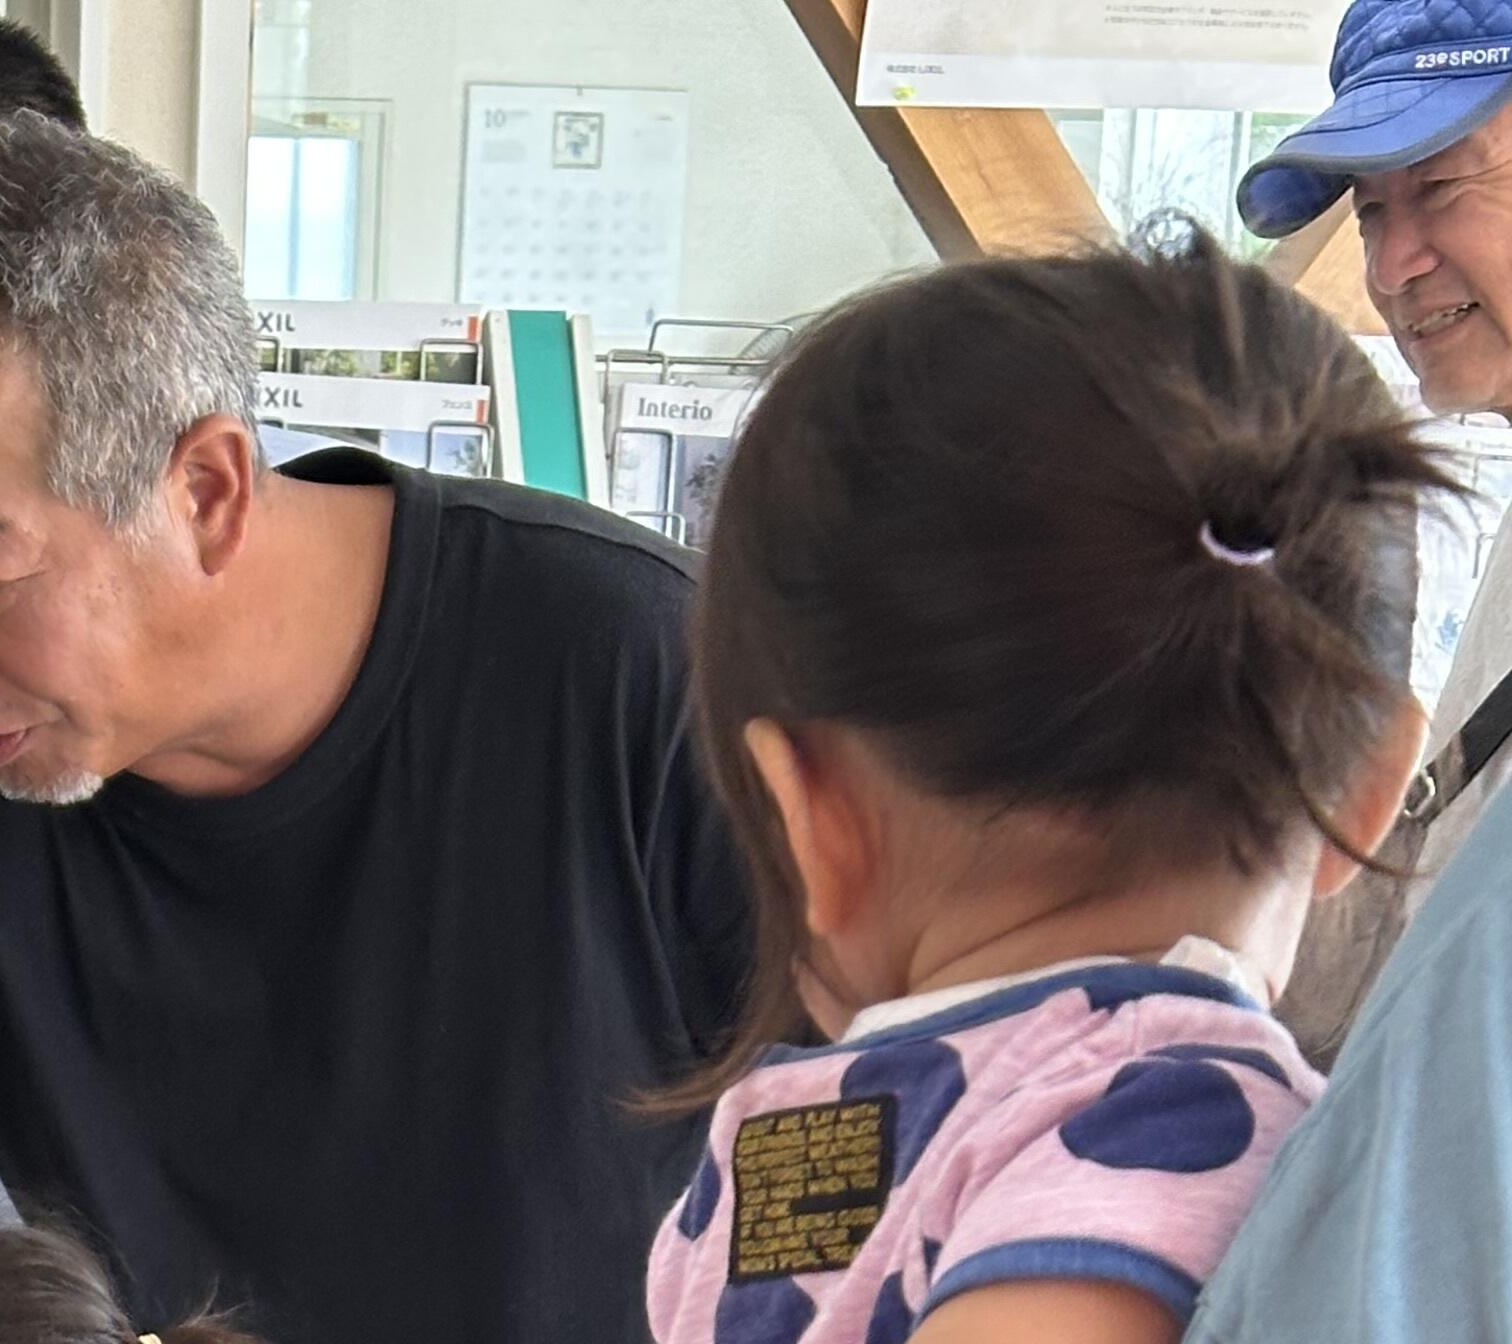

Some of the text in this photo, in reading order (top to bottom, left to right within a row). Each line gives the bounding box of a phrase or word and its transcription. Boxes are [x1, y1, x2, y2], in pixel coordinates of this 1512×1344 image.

[257, 312, 296, 332] XIL
[264, 387, 303, 408] XIL
[638, 397, 713, 420] Interio
